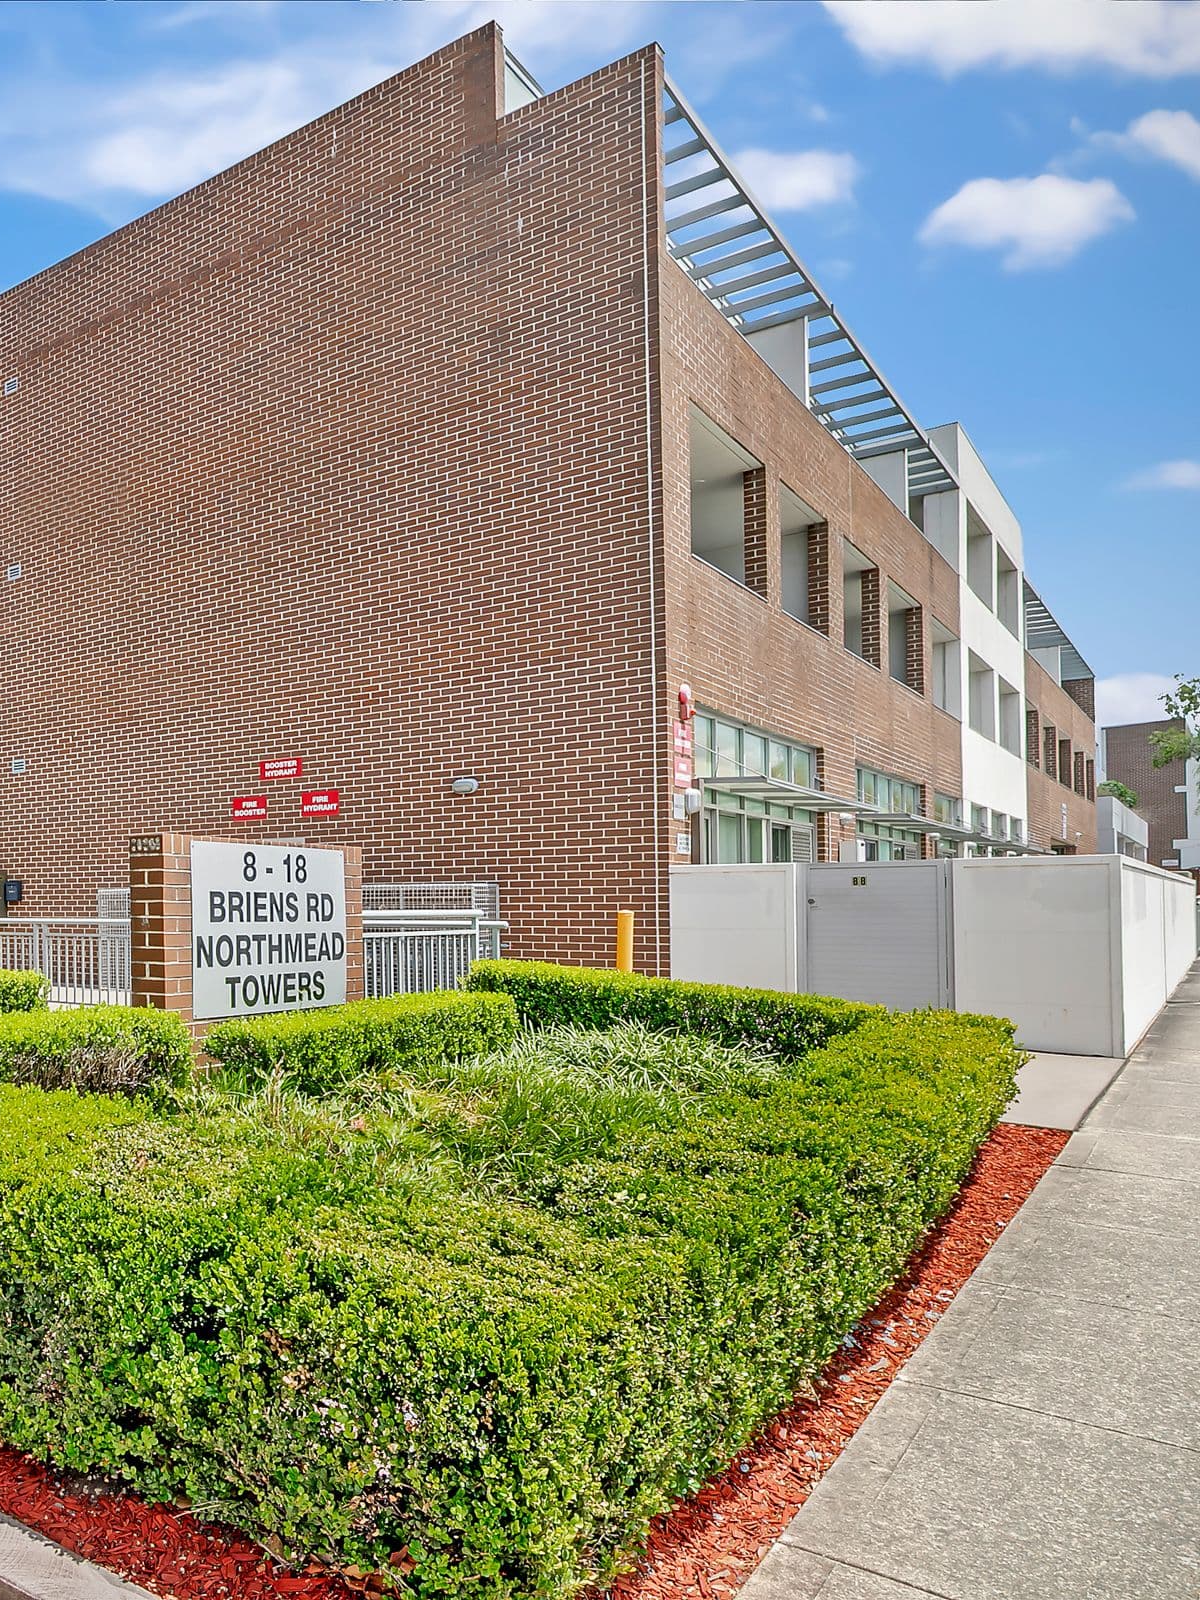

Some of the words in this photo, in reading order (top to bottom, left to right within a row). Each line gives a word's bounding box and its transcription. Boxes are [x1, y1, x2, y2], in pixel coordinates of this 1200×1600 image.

[265, 760, 297, 770] BOOSTER
[264, 768, 297, 778] HYDRANT
[311, 795, 329, 803] FIRE
[234, 808, 266, 817] BOOSTER
[303, 803, 338, 812] HYDRANT
[243, 851, 257, 882] 8
[282, 853, 307, 884] 18
[209, 891, 299, 923] BRIENS
[306, 893, 334, 922] RD
[196, 932, 345, 968] NORTHMEAD
[225, 970, 325, 1009] TOWERS
